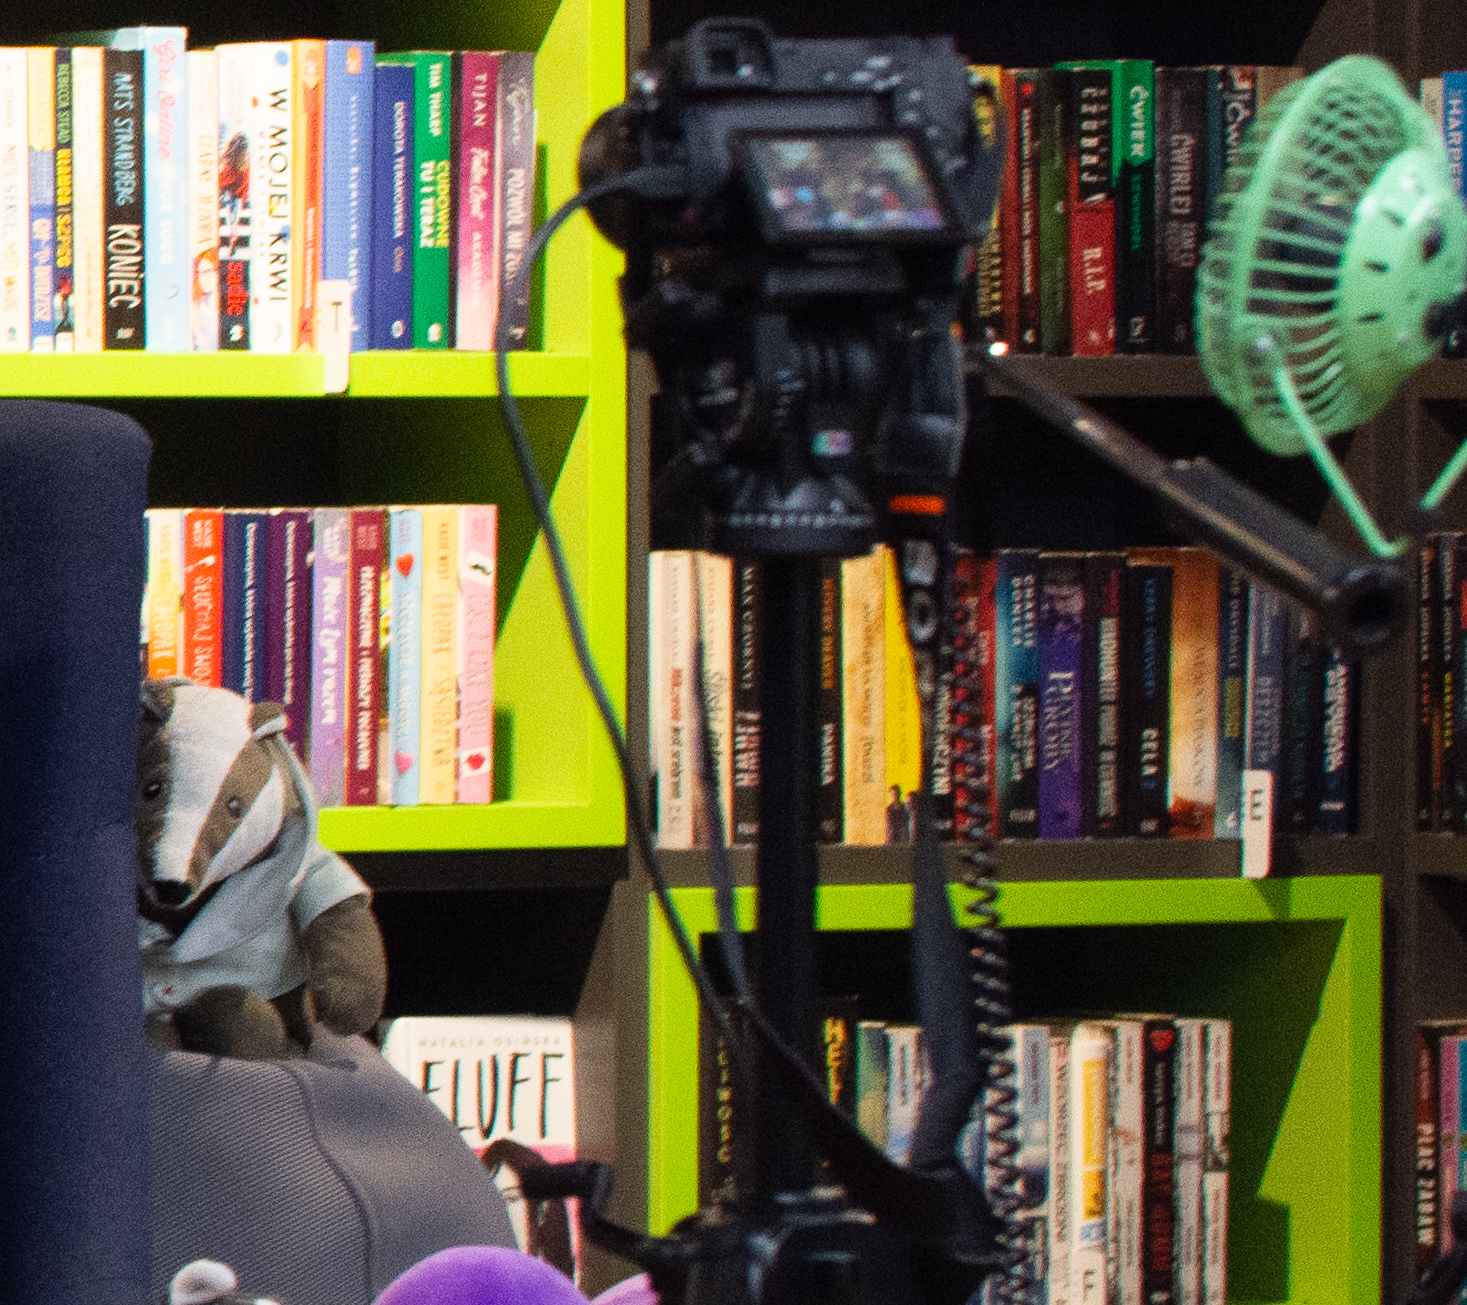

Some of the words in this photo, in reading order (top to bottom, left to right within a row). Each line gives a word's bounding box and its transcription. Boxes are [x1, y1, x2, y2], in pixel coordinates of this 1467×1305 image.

[270, 89, 287, 112] W
[472, 73, 487, 127] TIJAN
[268, 126, 287, 219] MOJEJ
[227, 262, 245, 317] sadie
[270, 233, 287, 302] KRWI
